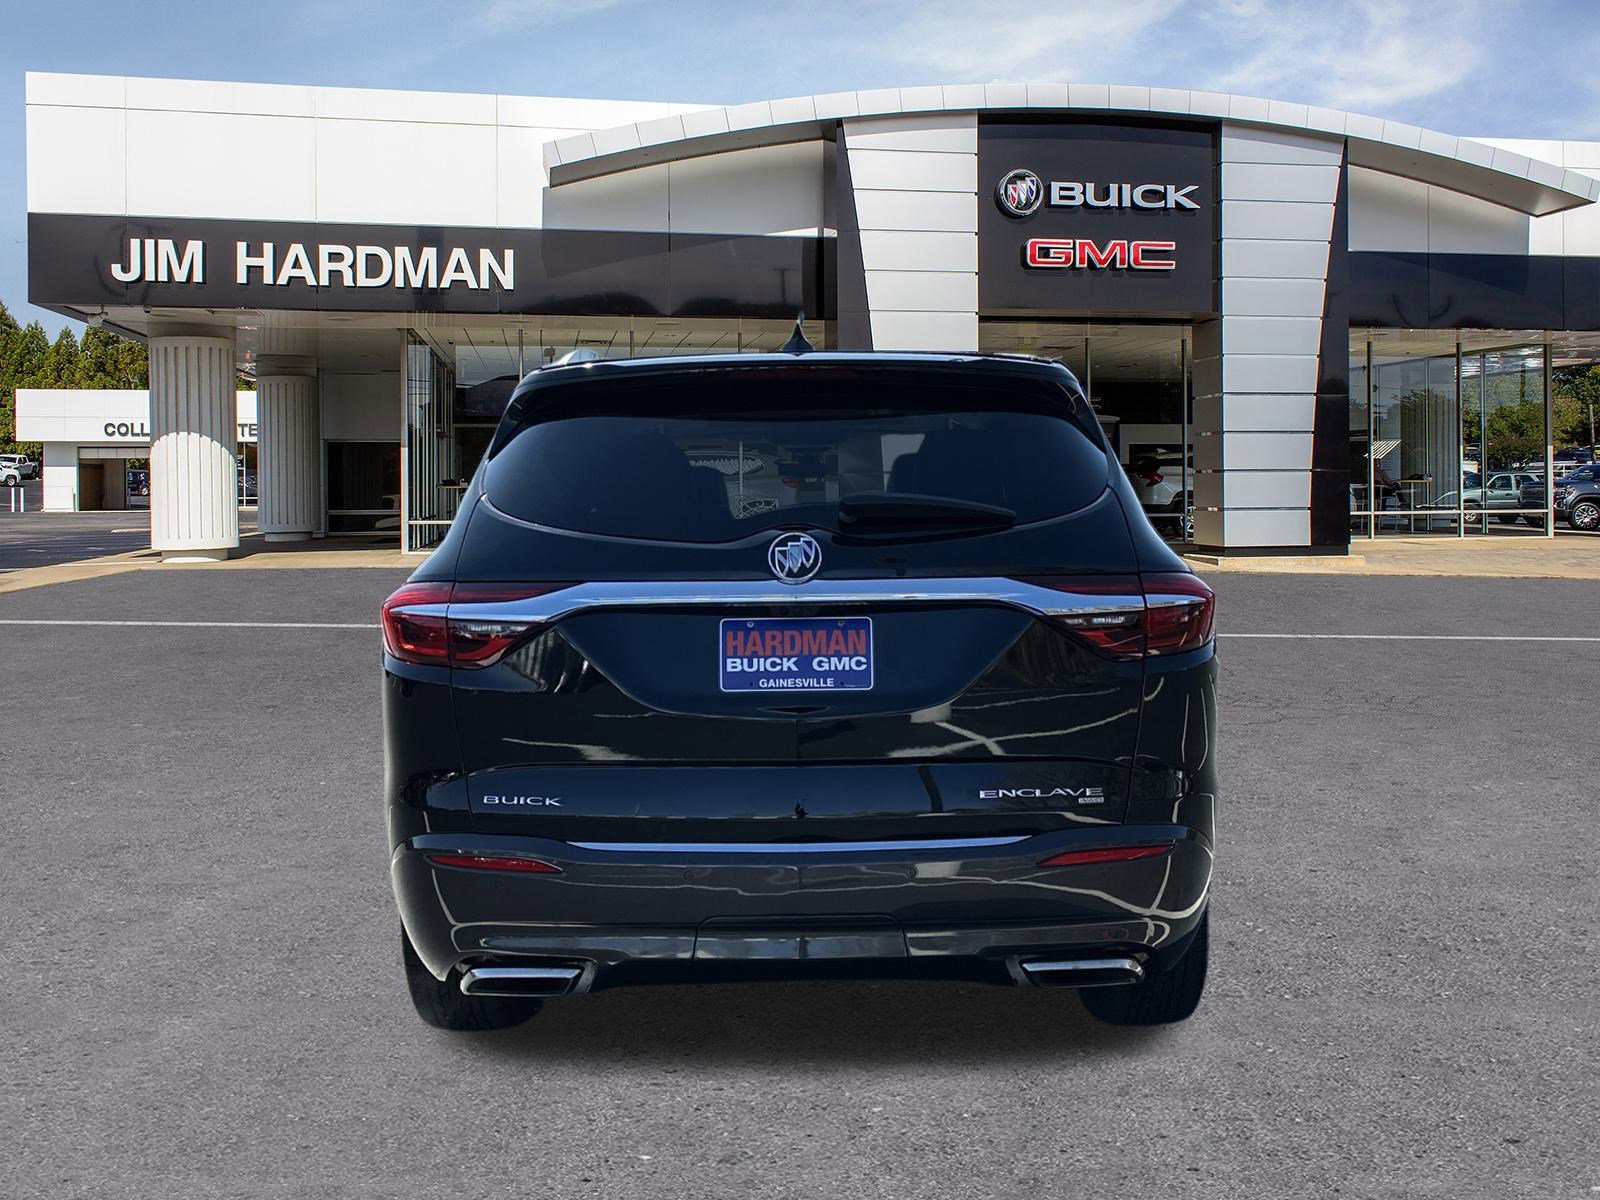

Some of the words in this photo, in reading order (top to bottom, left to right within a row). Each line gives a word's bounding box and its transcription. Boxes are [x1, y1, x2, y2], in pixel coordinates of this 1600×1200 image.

[1050, 182, 1200, 209] BUICK
[110, 237, 204, 283] JIM
[235, 240, 515, 290] HARDMAN
[1026, 238, 1176, 270] GMC
[726, 629, 867, 657] HARDMAN
[726, 657, 799, 672] BUICK
[812, 656, 867, 671] GMC
[760, 678, 834, 688] GAINESVILLE
[483, 795, 563, 806] BUICK
[979, 787, 1104, 798] ENCLAVE
